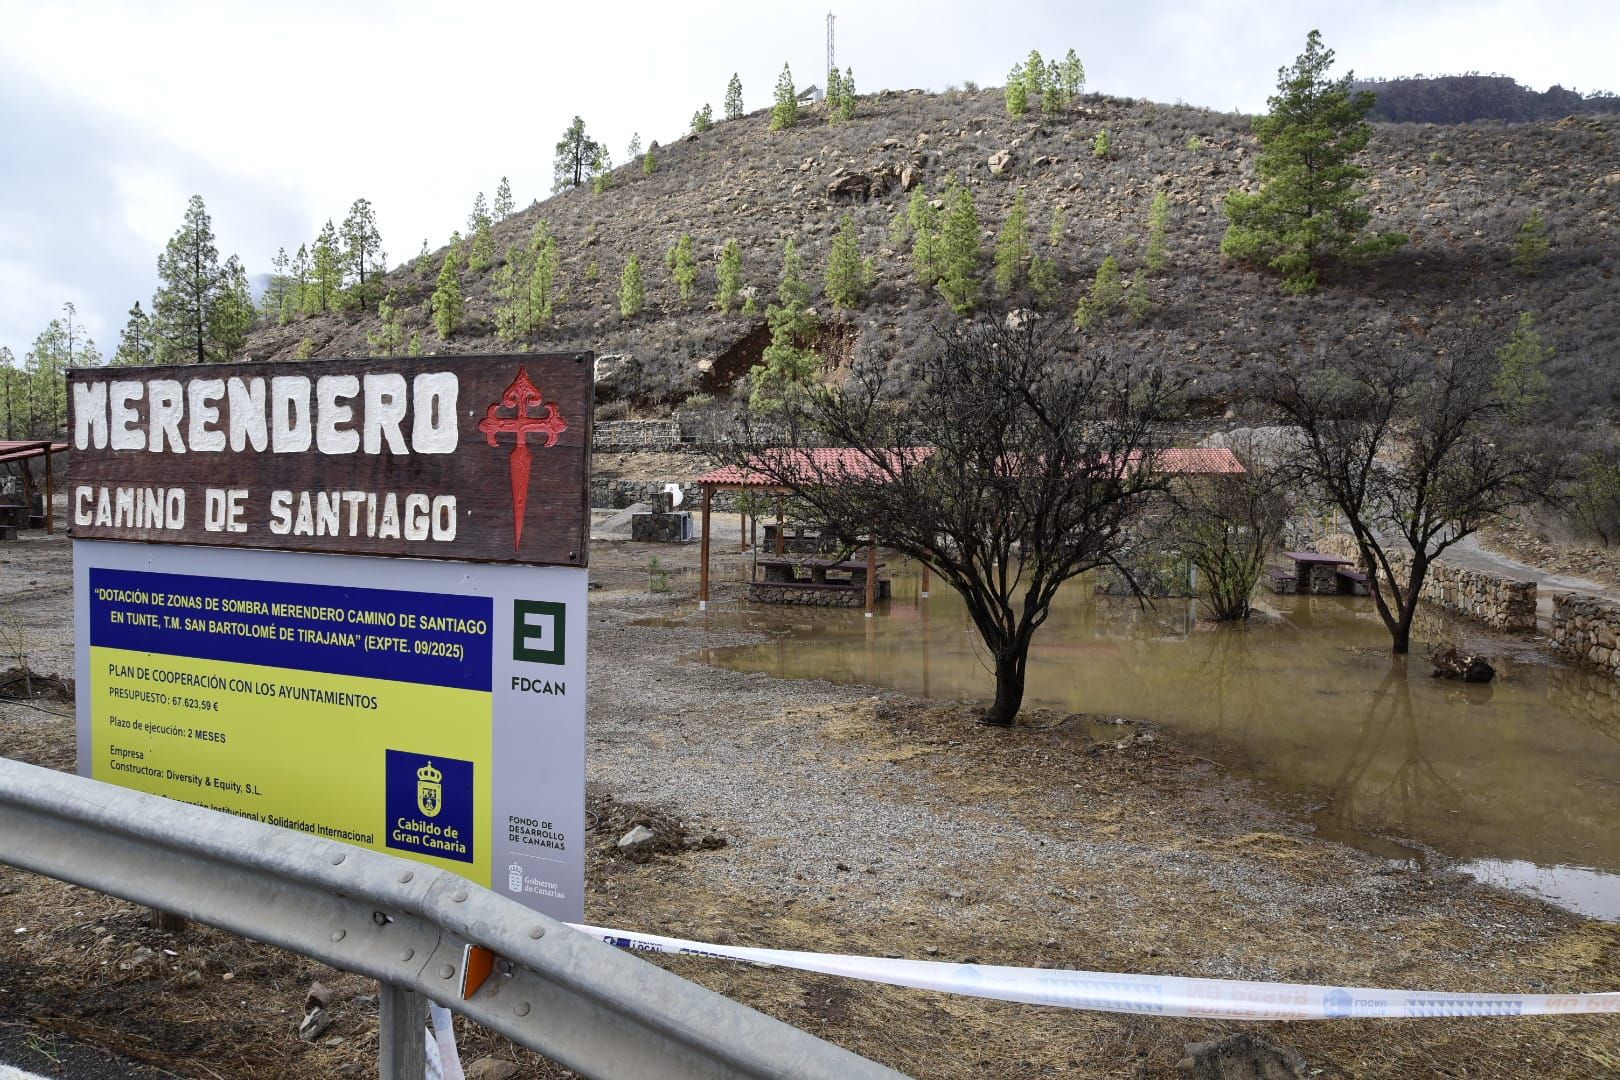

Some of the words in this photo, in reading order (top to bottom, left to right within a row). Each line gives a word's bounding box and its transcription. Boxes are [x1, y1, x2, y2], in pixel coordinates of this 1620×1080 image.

[73, 371, 459, 455] MERENDERO
[74, 485, 186, 530] CAMINO
[205, 488, 249, 532] DE
[269, 489, 457, 542] SANTIAGO
[151, 593, 165, 606] DE
[167, 594, 202, 610] ZONAS
[205, 597, 219, 610] DE
[222, 598, 268, 615] SOMBRA
[271, 603, 344, 623] MERENDERO
[347, 609, 396, 628] CAMINO
[399, 614, 416, 629] DE
[419, 615, 487, 635] SANTIAGO
[111, 610, 124, 624] EN
[126, 612, 161, 630] TUNTE,
[163, 615, 182, 631] T.M.
[184, 617, 206, 632] SAN
[209, 620, 276, 640] BARTOLOMÉ
[279, 626, 294, 641] DE
[364, 634, 412, 653] (EXPTE.
[414, 639, 464, 661] 09/2025)
[108, 664, 134, 679] PLAN
[136, 666, 150, 680] DE
[152, 667, 227, 691] COOPERACIÓN
[229, 677, 253, 693] CON
[255, 680, 276, 697] LOS
[278, 684, 378, 710] AYUNTAMIENTOS
[511, 676, 566, 696] FDCAN
[109, 687, 170, 705] PRESUPUESTO:
[172, 695, 211, 711] 67.623,59
[213, 701, 219, 711] €
[109, 715, 131, 730] Plazo
[132, 718, 143, 731] de
[144, 720, 186, 738] ejecución:
[187, 727, 193, 738] 2
[194, 729, 226, 743] MESES
[110, 744, 144, 760] Empresa
[110, 760, 164, 778] Constructora:
[166, 769, 202, 787] Diversity
[205, 776, 212, 787] &
[213, 777, 243, 794] Equity,
[245, 783, 262, 796] S.L.
[268, 814, 315, 833] Solidaridad
[317, 823, 374, 844] Internacional
[397, 817, 440, 838] Cabildo
[443, 824, 459, 840] de
[509, 815, 539, 828] FONDO
[541, 821, 553, 830] DE
[509, 824, 565, 841] DESARROLLO
[392, 829, 419, 846] Gran
[422, 834, 467, 854] Canaria
[509, 833, 520, 843] DE
[522, 836, 565, 851] CANARIAS
[524, 876, 558, 889] Gobierno
[524, 885, 533, 893] de
[533, 886, 565, 899] Canarias
